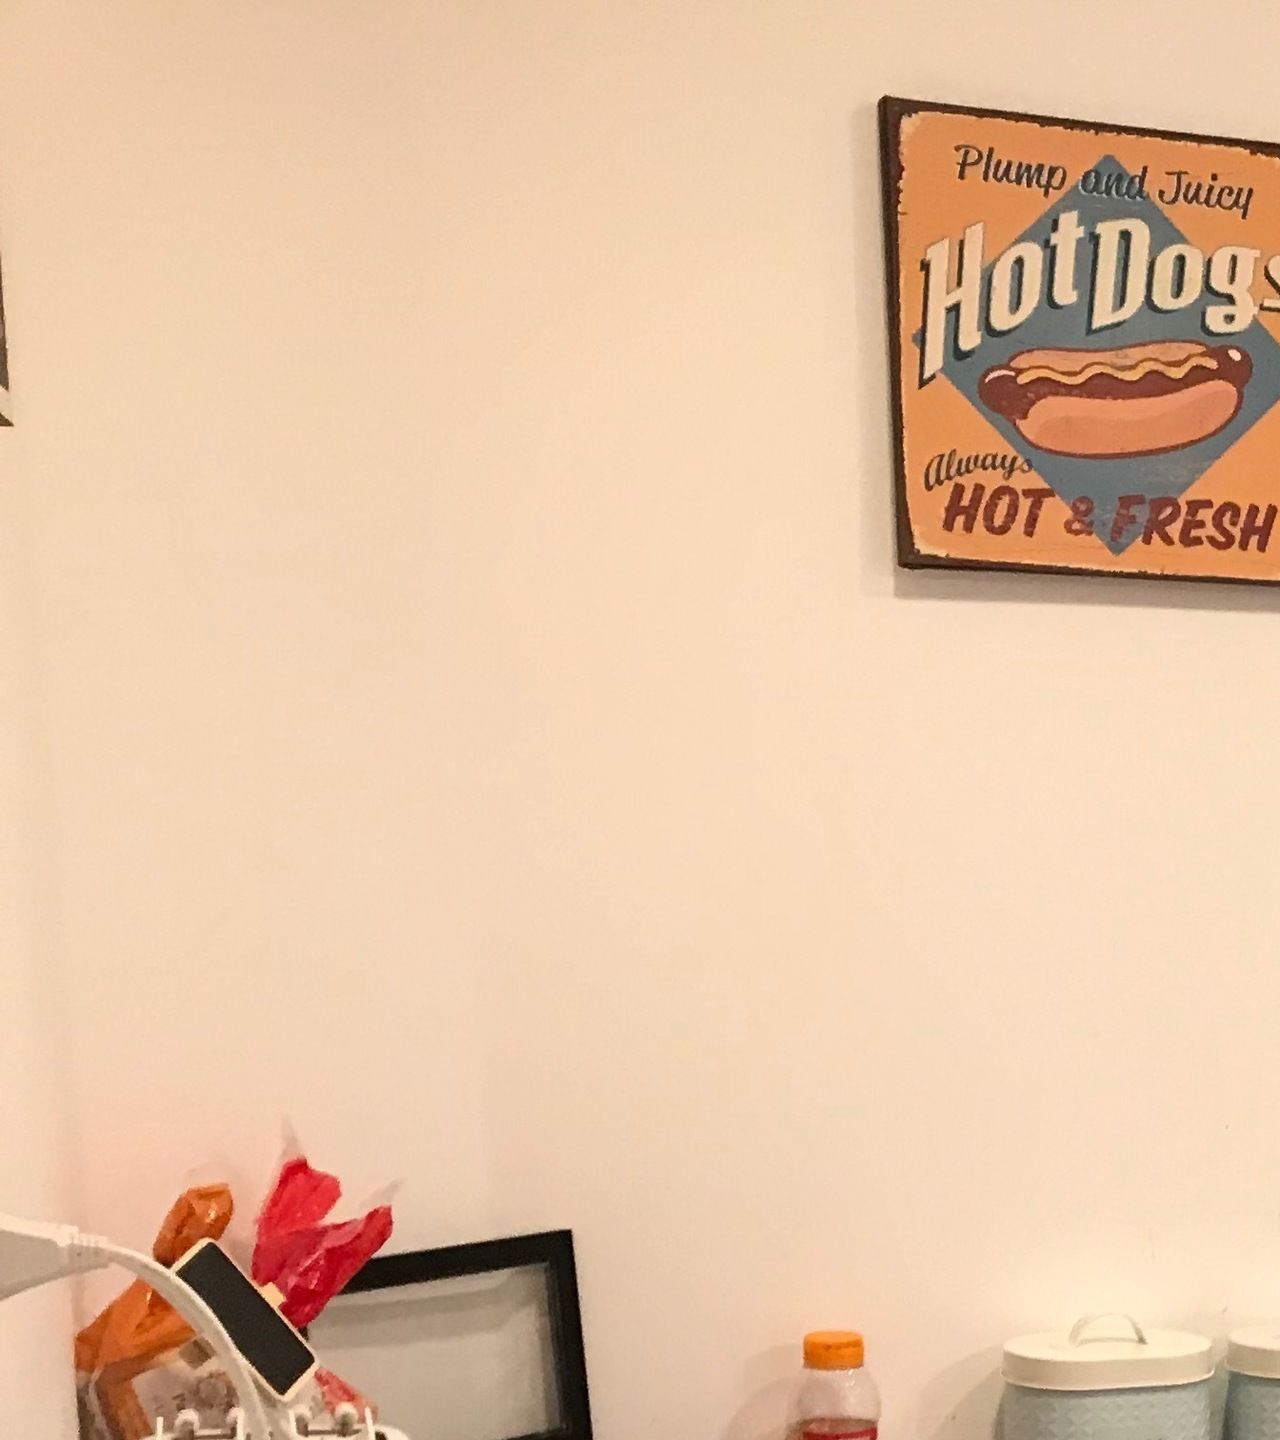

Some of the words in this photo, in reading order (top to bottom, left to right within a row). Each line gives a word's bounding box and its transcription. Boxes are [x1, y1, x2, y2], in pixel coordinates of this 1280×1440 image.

[954, 144, 1067, 198] Plump
[1079, 166, 1148, 200] and
[1158, 170, 1254, 219] Juicy
[924, 449, 1034, 492] Always
[942, 482, 1056, 538] HOT
[1064, 497, 1097, 536] &
[1110, 493, 1279, 554] FRESH
